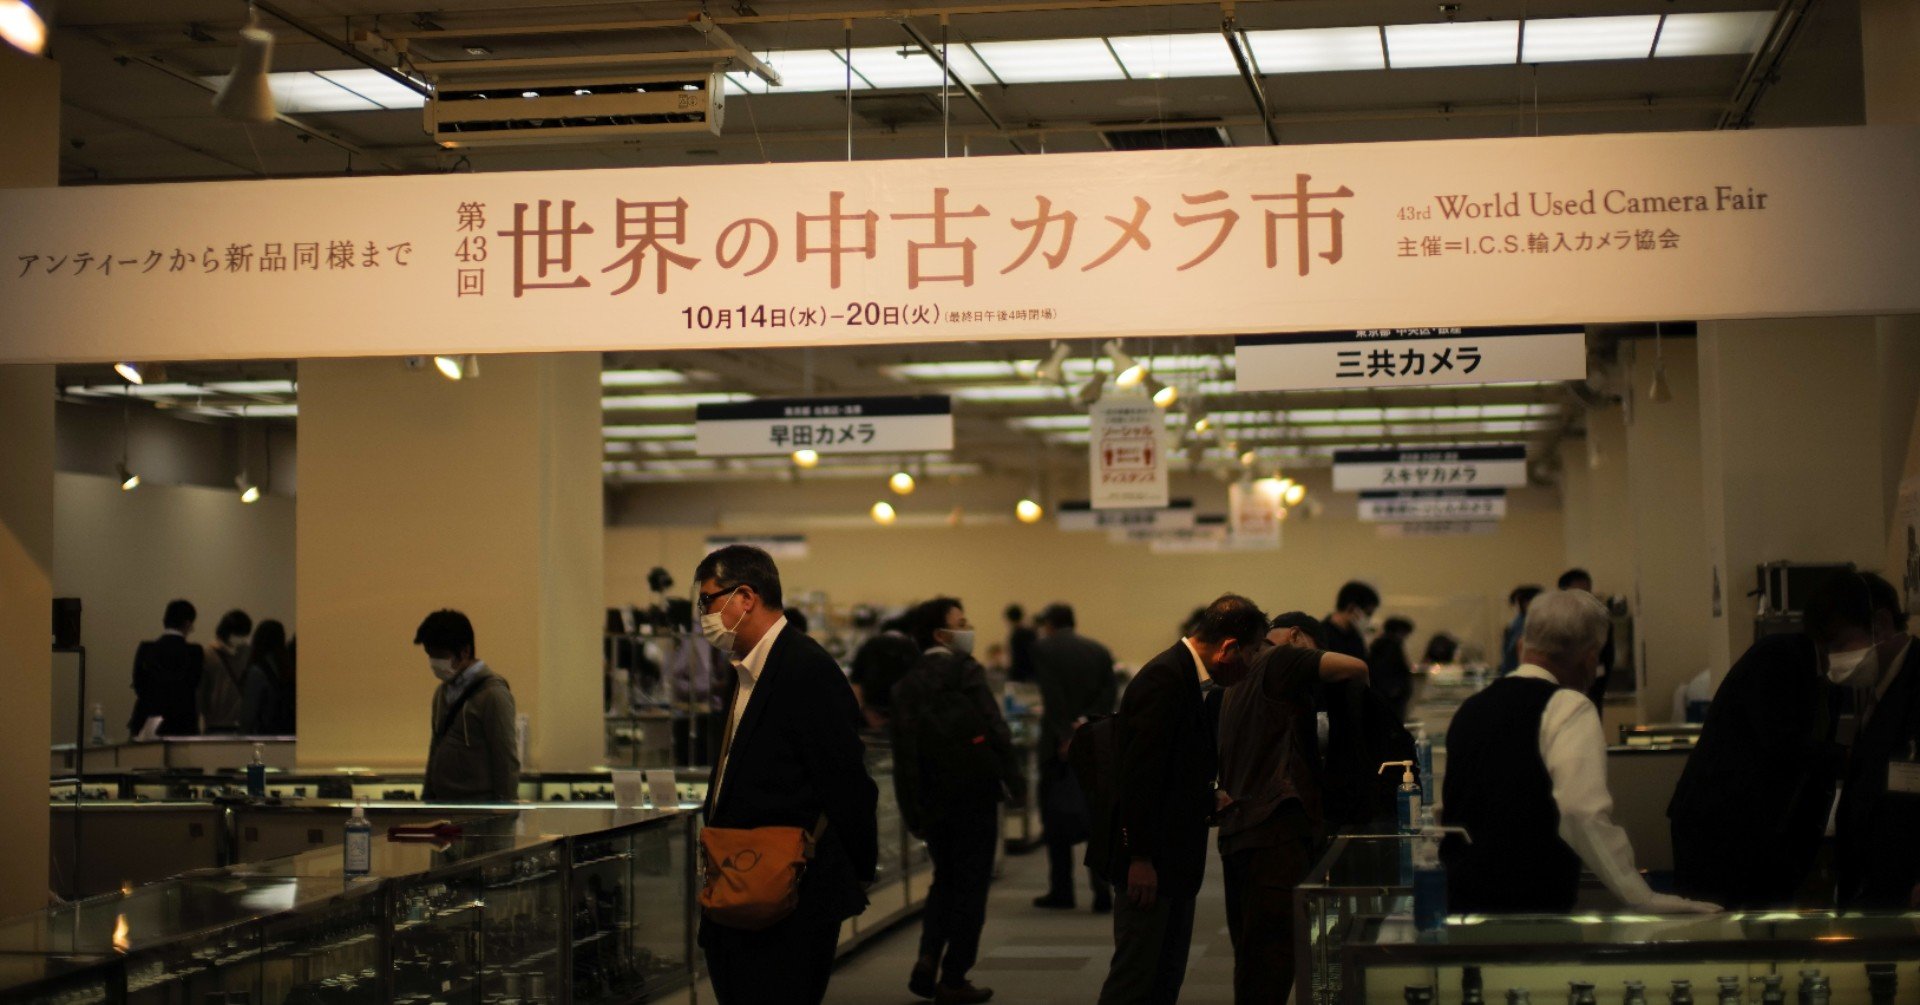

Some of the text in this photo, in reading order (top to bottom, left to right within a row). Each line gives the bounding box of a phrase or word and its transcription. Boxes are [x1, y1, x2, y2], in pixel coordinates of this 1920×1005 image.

[1397, 186, 1769, 221] 43rd World Used Camera Fair
[455, 202, 487, 298] 第43回
[497, 173, 1355, 298] 世界の中古カメラ市
[18, 241, 413, 278] アンティークから新品同様まで
[1336, 346, 1482, 378] 三共カメラ
[769, 423, 876, 447] 早田カメラ
